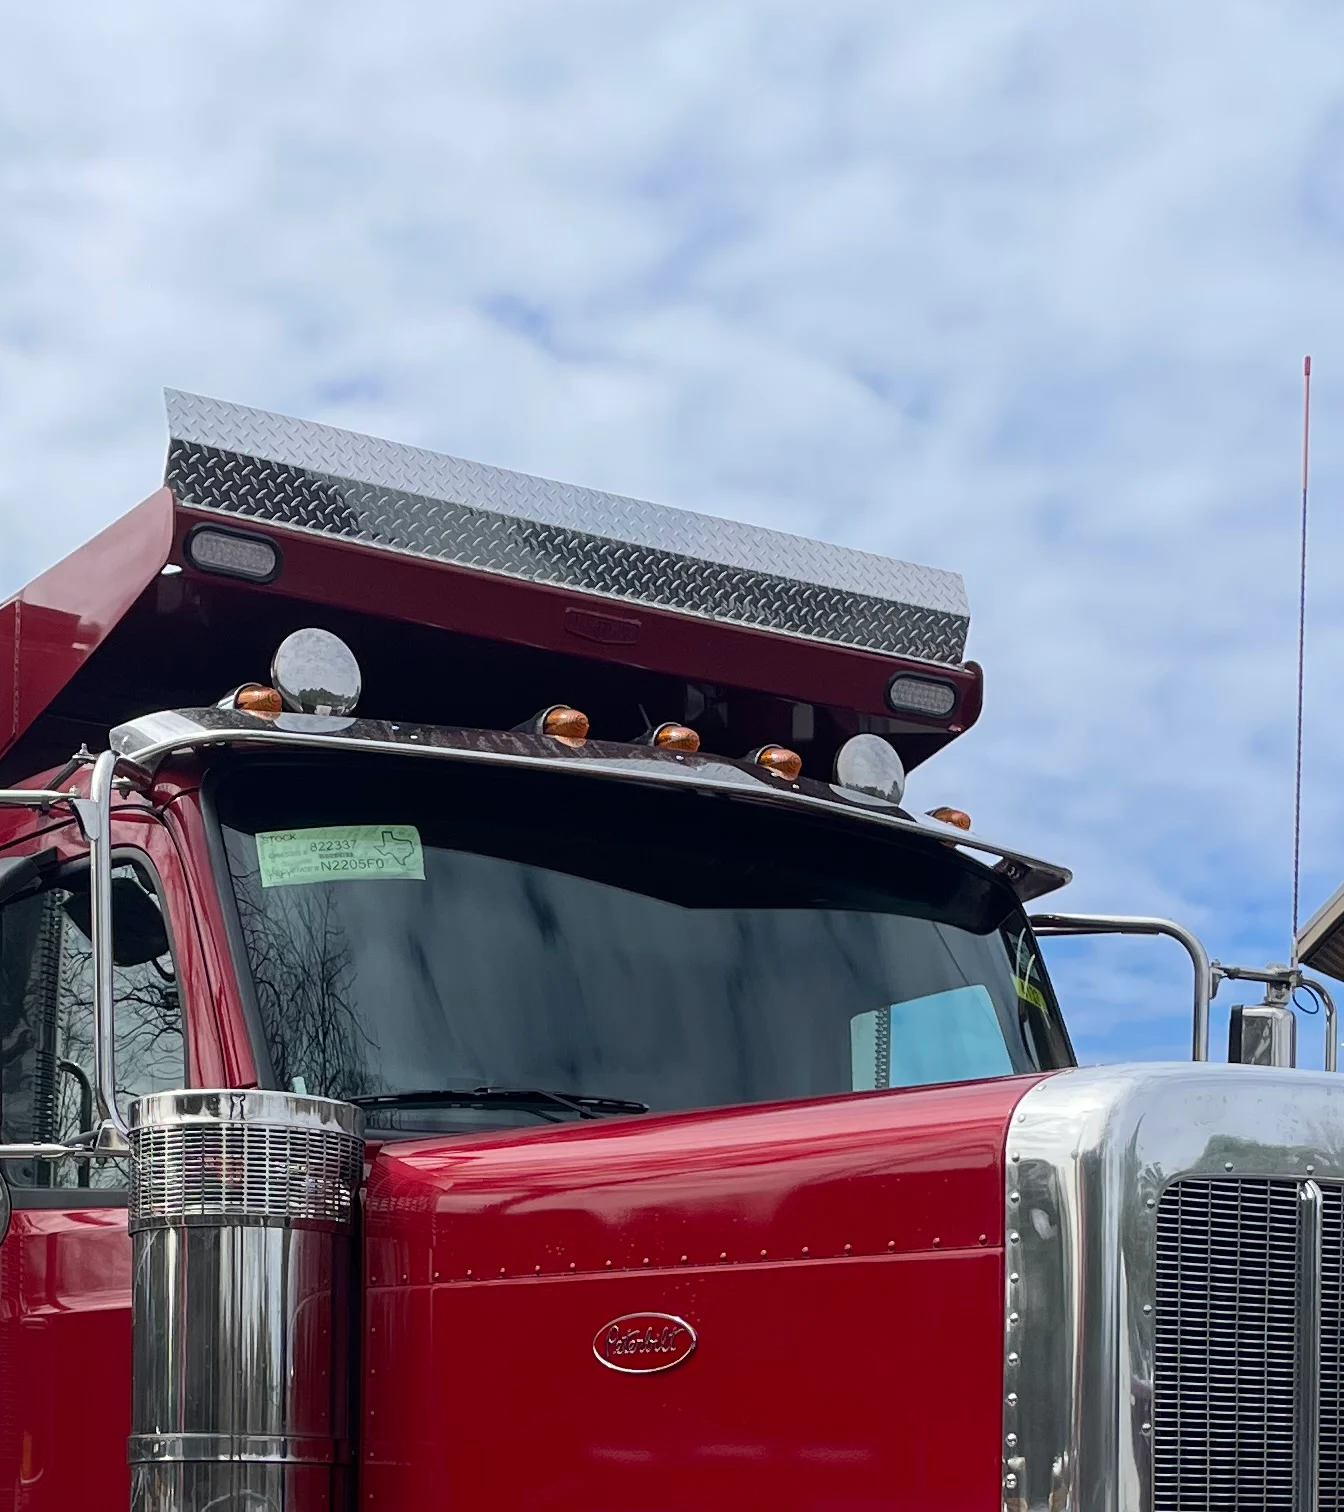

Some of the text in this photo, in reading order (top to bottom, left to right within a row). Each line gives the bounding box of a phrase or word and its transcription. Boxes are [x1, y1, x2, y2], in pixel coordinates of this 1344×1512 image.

[262, 833, 297, 845] STOCK
[310, 840, 357, 853] 822337
[320, 858, 385, 872] N2205F0
[604, 1324, 687, 1359] Peterbilt
